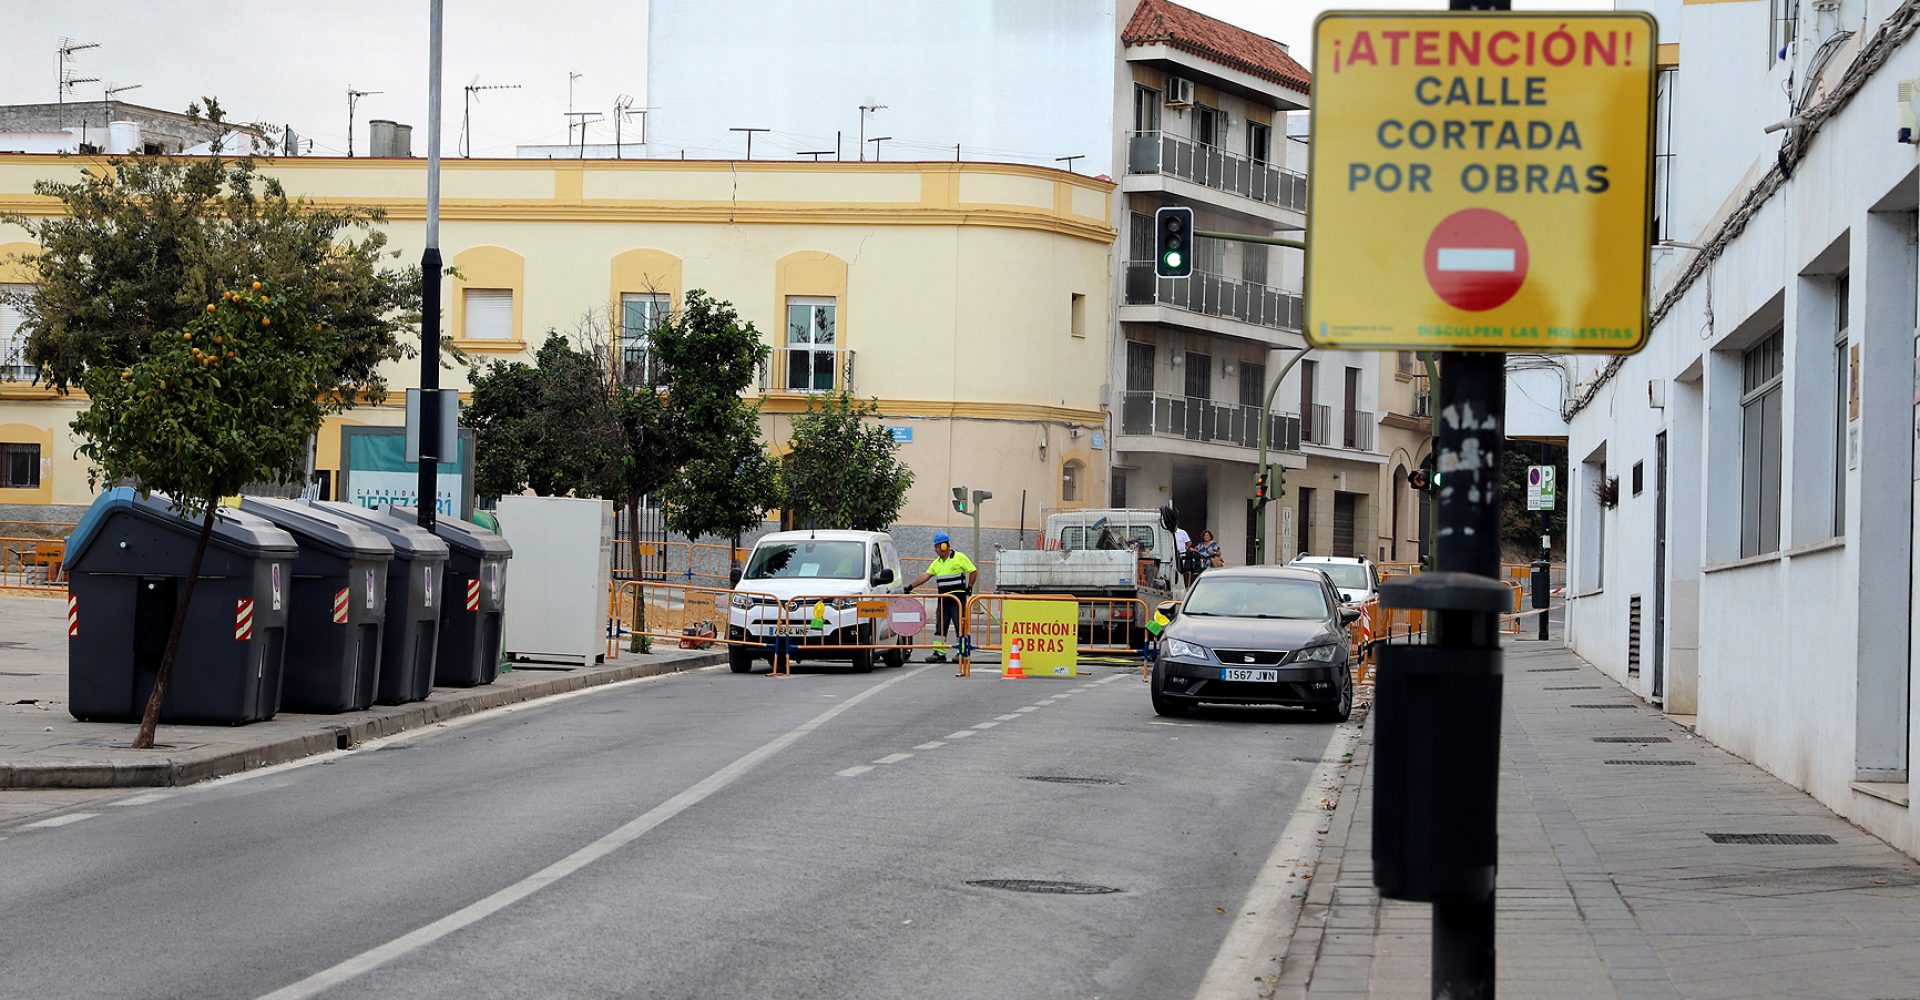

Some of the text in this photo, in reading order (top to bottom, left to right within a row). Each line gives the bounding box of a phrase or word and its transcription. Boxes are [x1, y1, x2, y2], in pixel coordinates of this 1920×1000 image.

[1333, 23, 1633, 73] ¡ATENCIÓN!
[1415, 76, 1548, 106] CALLE
[1376, 120, 1582, 150] CORTADA
[1348, 163, 1610, 194] POR OBRAS
[1418, 325, 1633, 340] DISCULPEN LAS MOLESTIAS
[357, 488, 452, 498] CANDIDARA
[1017, 637, 1064, 653] OBRAS
[1229, 670, 1275, 681] 1567 JWN
